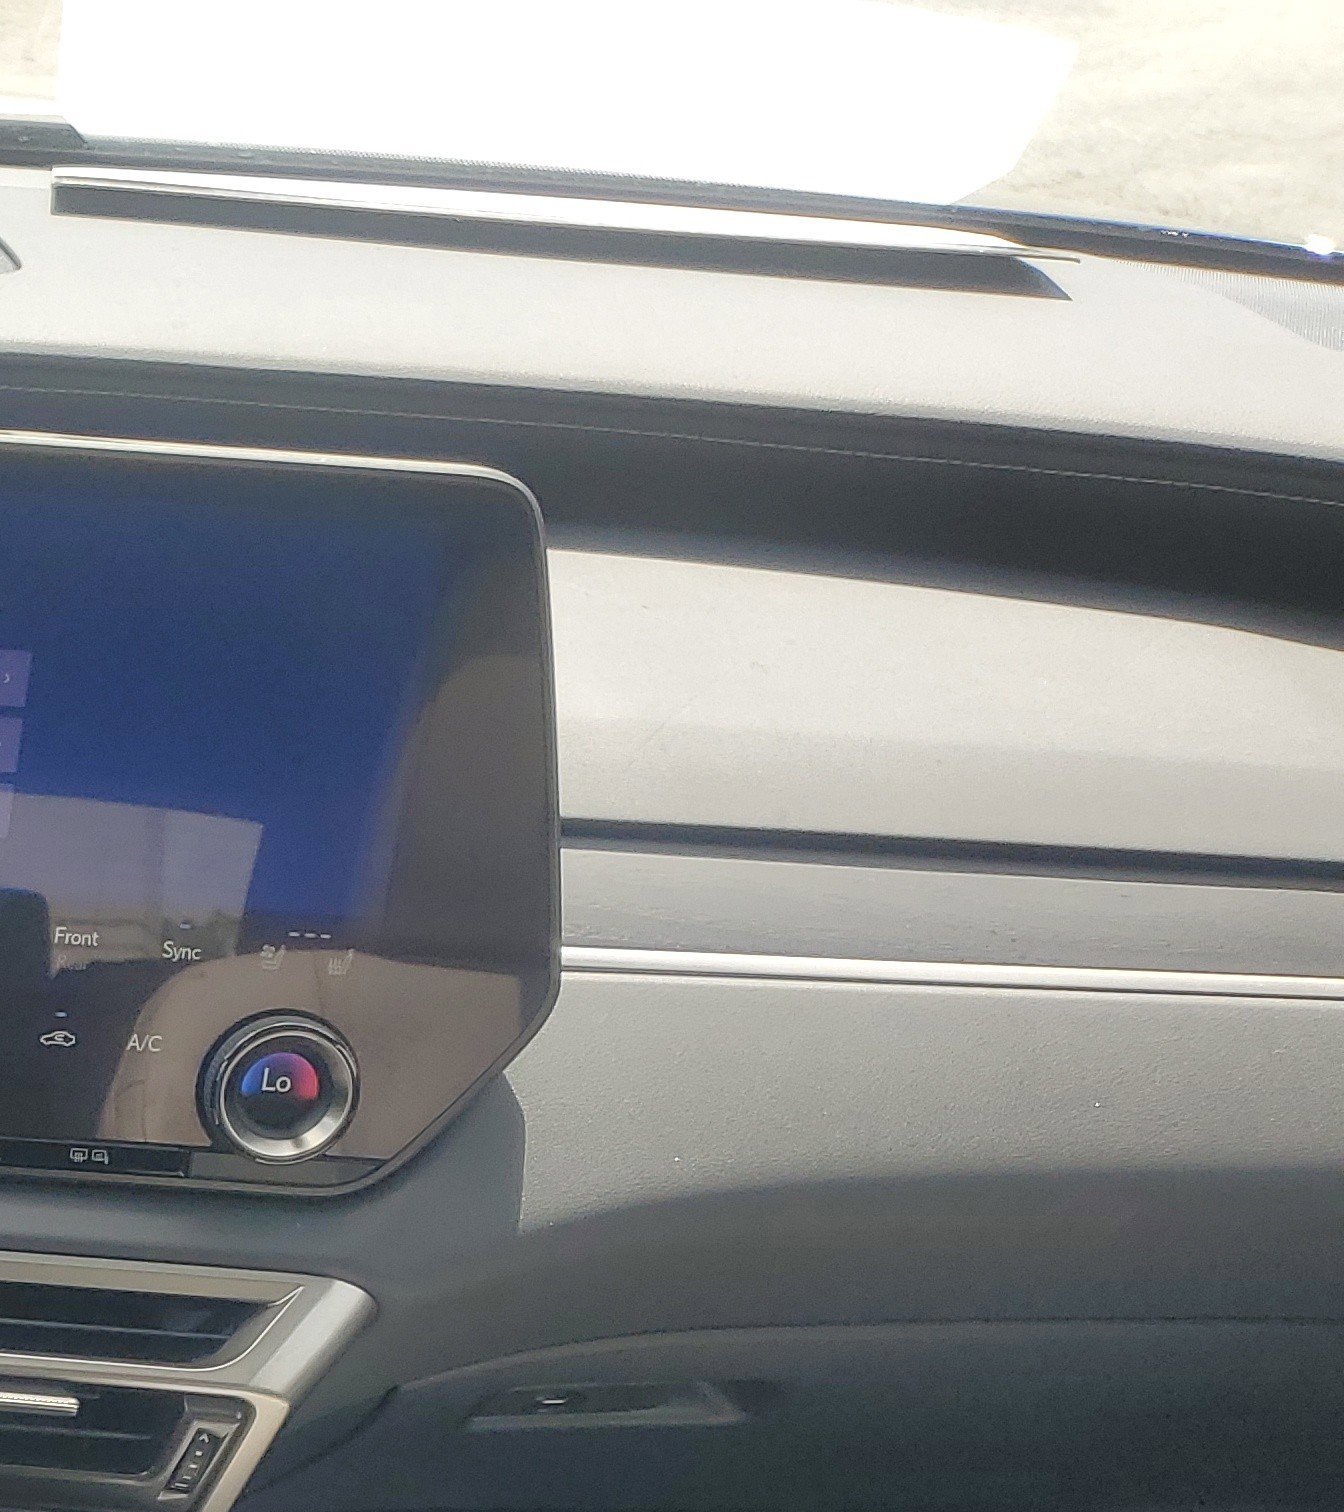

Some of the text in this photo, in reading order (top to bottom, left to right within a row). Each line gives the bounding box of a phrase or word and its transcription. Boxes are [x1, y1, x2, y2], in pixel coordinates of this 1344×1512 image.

[54, 927, 100, 947] Front
[162, 941, 202, 962] Sync
[125, 1034, 163, 1052] A/C
[261, 1067, 292, 1093] Lo
